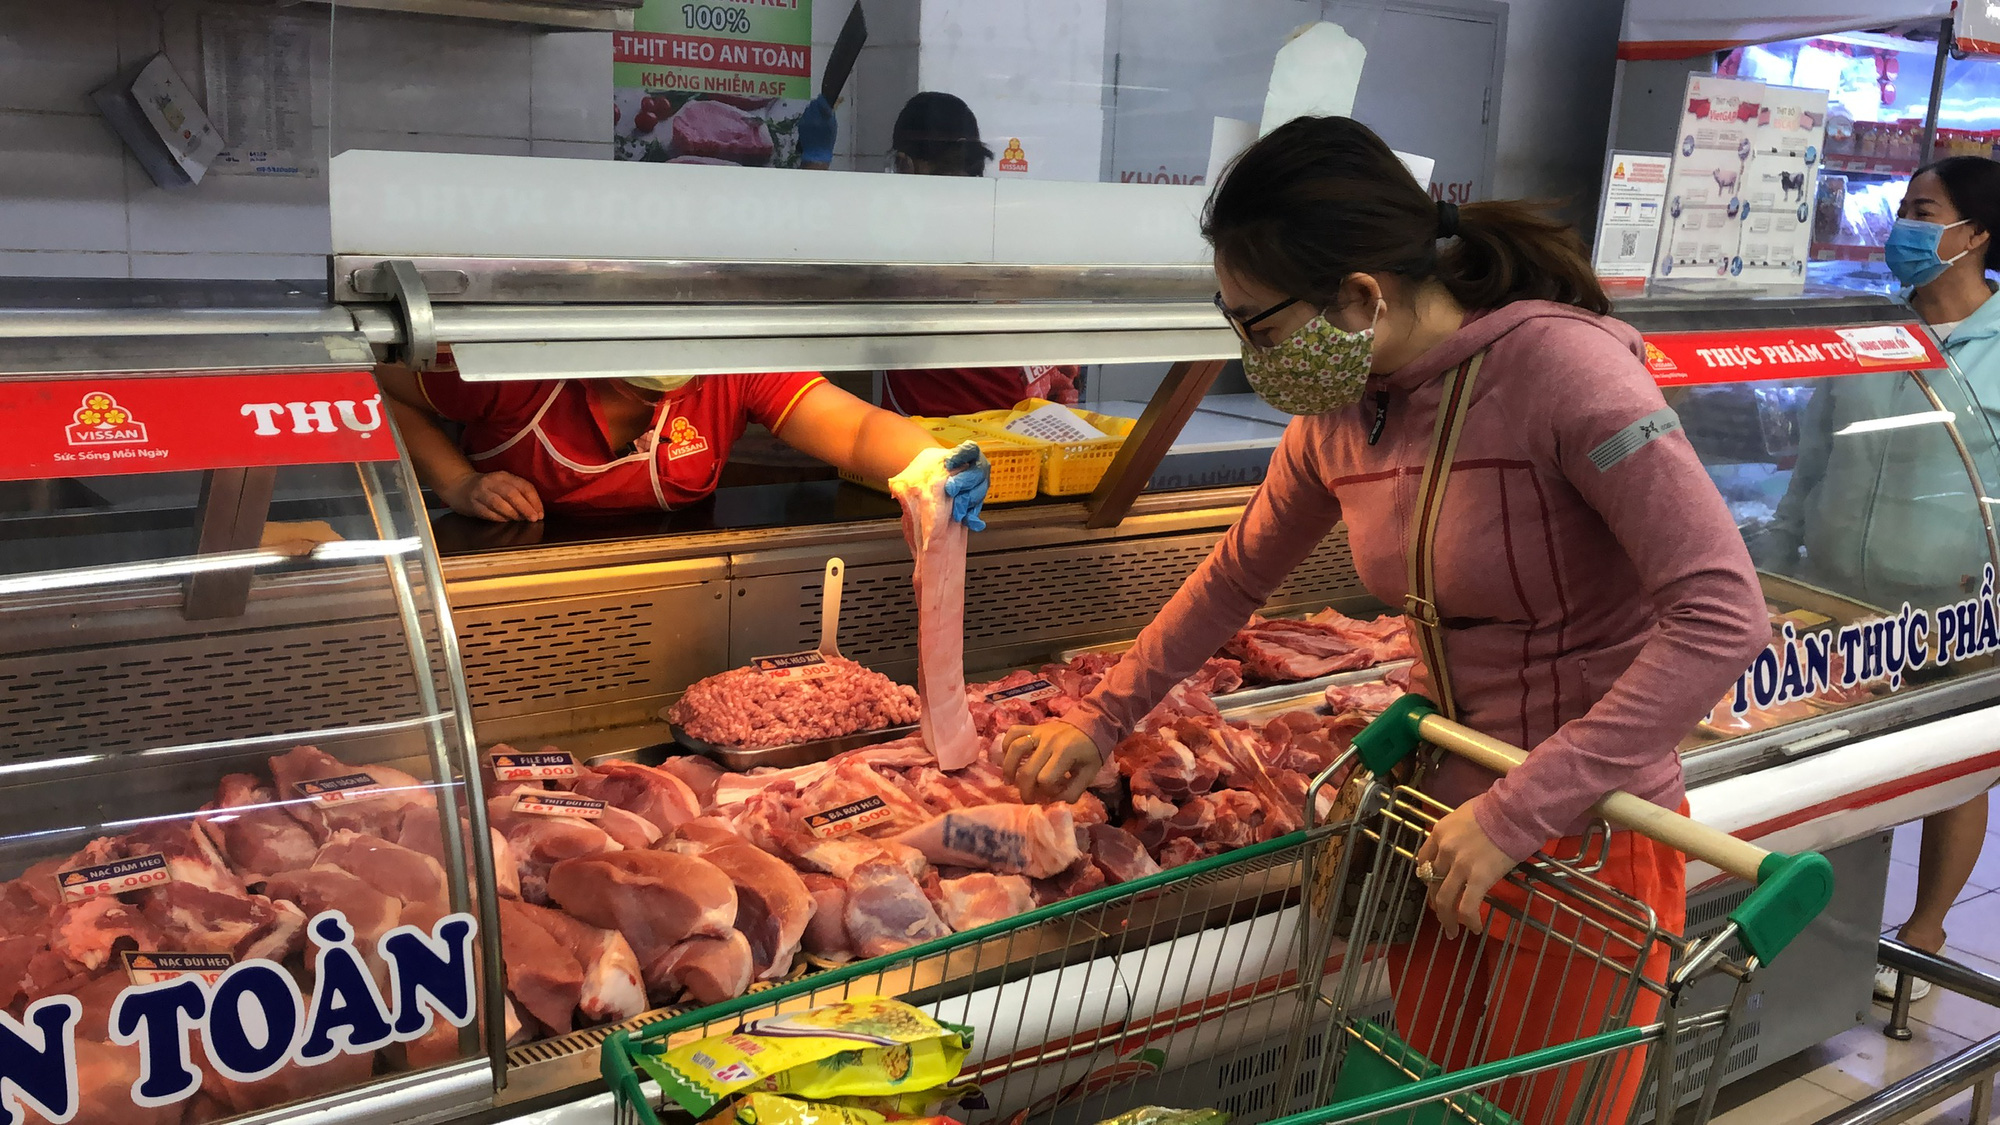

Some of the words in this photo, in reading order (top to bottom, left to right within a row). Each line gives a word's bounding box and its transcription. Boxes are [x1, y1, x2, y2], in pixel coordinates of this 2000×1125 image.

[682, 4, 750, 33] 100%
[620, 37, 668, 62] THỊT
[673, 41, 715, 62] HEO
[720, 45, 748, 64] AN
[752, 46, 804, 69] TOÀN
[641, 68, 700, 90] KHÔNG
[704, 74, 755, 94] NHIỄM
[759, 80, 786, 96] ASF
[1001, 163, 1027, 171] VISSAN
[1120, 166, 1204, 185] KHÔNG
[1696, 344, 1762, 369] THỰC
[1759, 339, 1826, 364] PHẨM
[76, 429, 139, 441] VISSAN
[54, 452, 76, 461] Sức
[78, 450, 111, 461] Sống
[112, 449, 136, 459] Mỗi
[138, 448, 169, 458] Ngày
[672, 442, 704, 455] VISSAN
[790, 656, 807, 664] HEO
[805, 653, 820, 662] XAY
[1732, 622, 1831, 715] TOÀN
[1838, 604, 1929, 690] THỰC
[542, 756, 564, 764] HEO
[583, 801, 602, 809] HEO
[828, 811, 843, 820] BA
[843, 806, 861, 816] RỌI
[860, 798, 881, 810] HEO
[89, 869, 111, 878] NẠC
[139, 858, 161, 868] HEO
[158, 957, 183, 968] NẠC
[206, 958, 230, 967] HEO
[112, 913, 474, 1103] TOÀN
